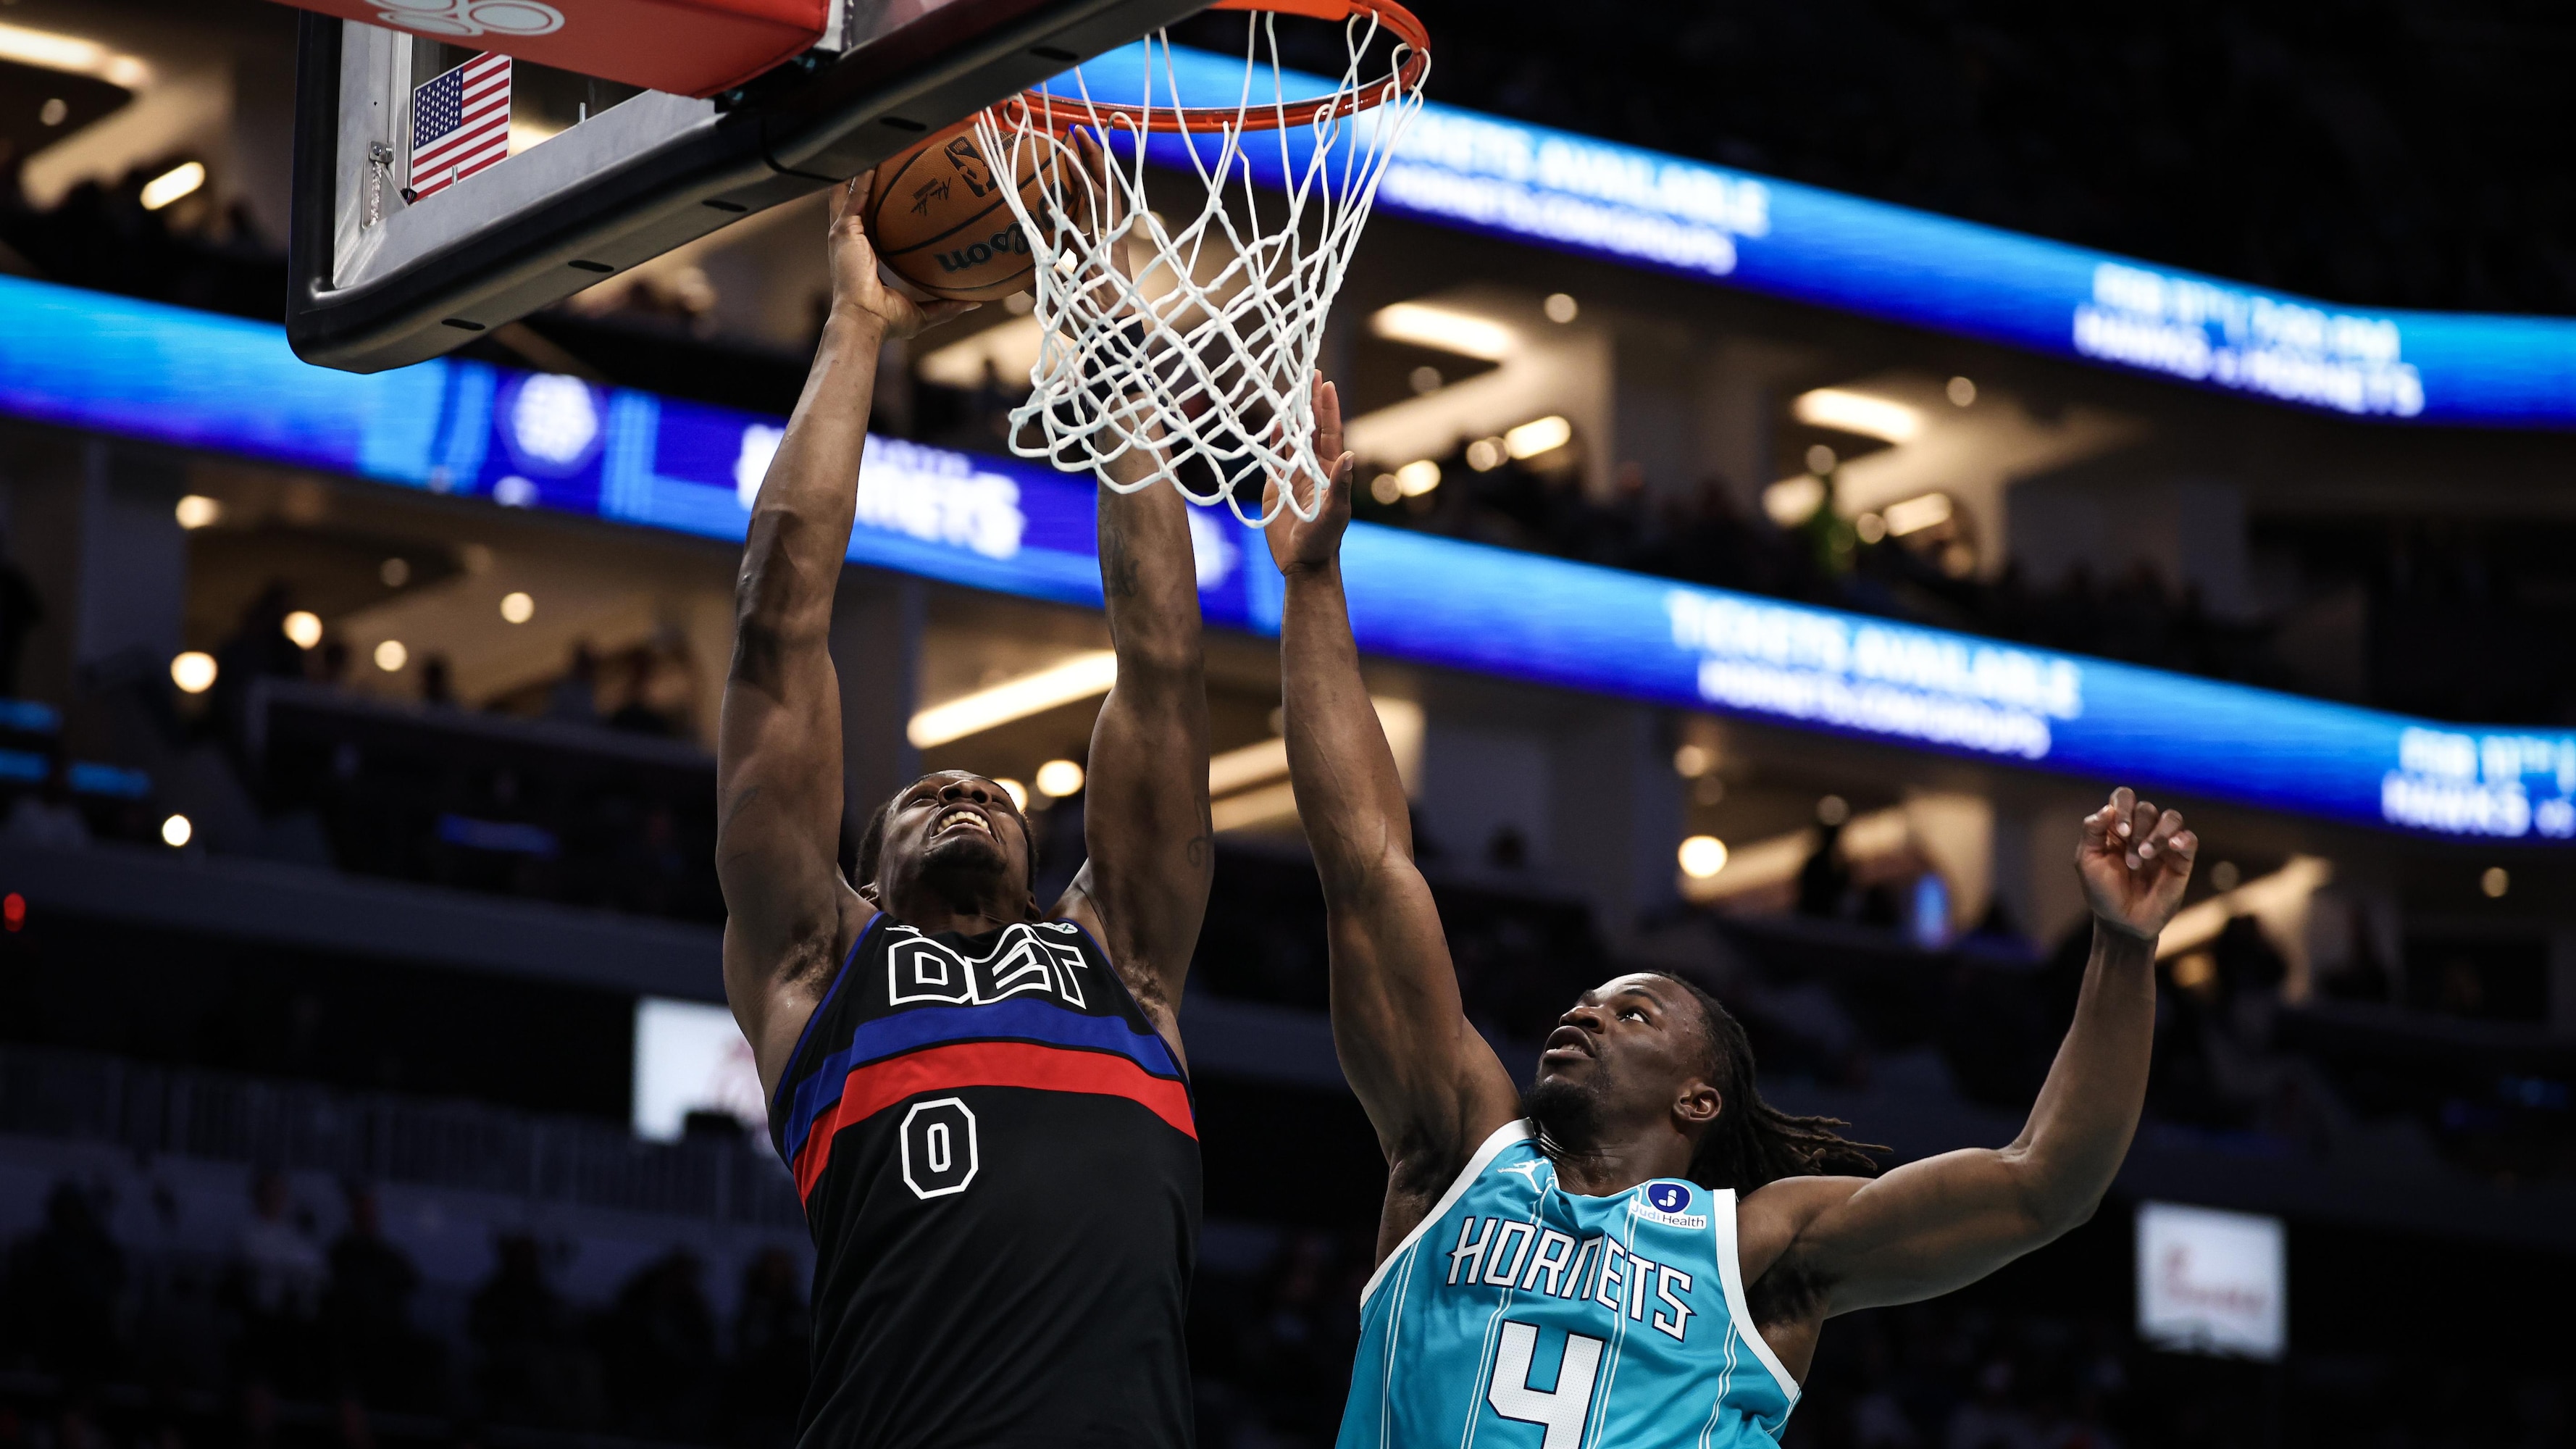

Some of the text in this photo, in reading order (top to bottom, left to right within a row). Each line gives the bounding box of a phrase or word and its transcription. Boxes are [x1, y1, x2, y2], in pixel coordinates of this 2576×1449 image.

[888, 923, 1088, 1010] DET
[900, 1096, 979, 1199] 0
[1631, 1204, 1704, 1227] Judi Health
[1446, 1216, 1696, 1342] HORNETS
[1486, 1319, 1605, 1449] 4
